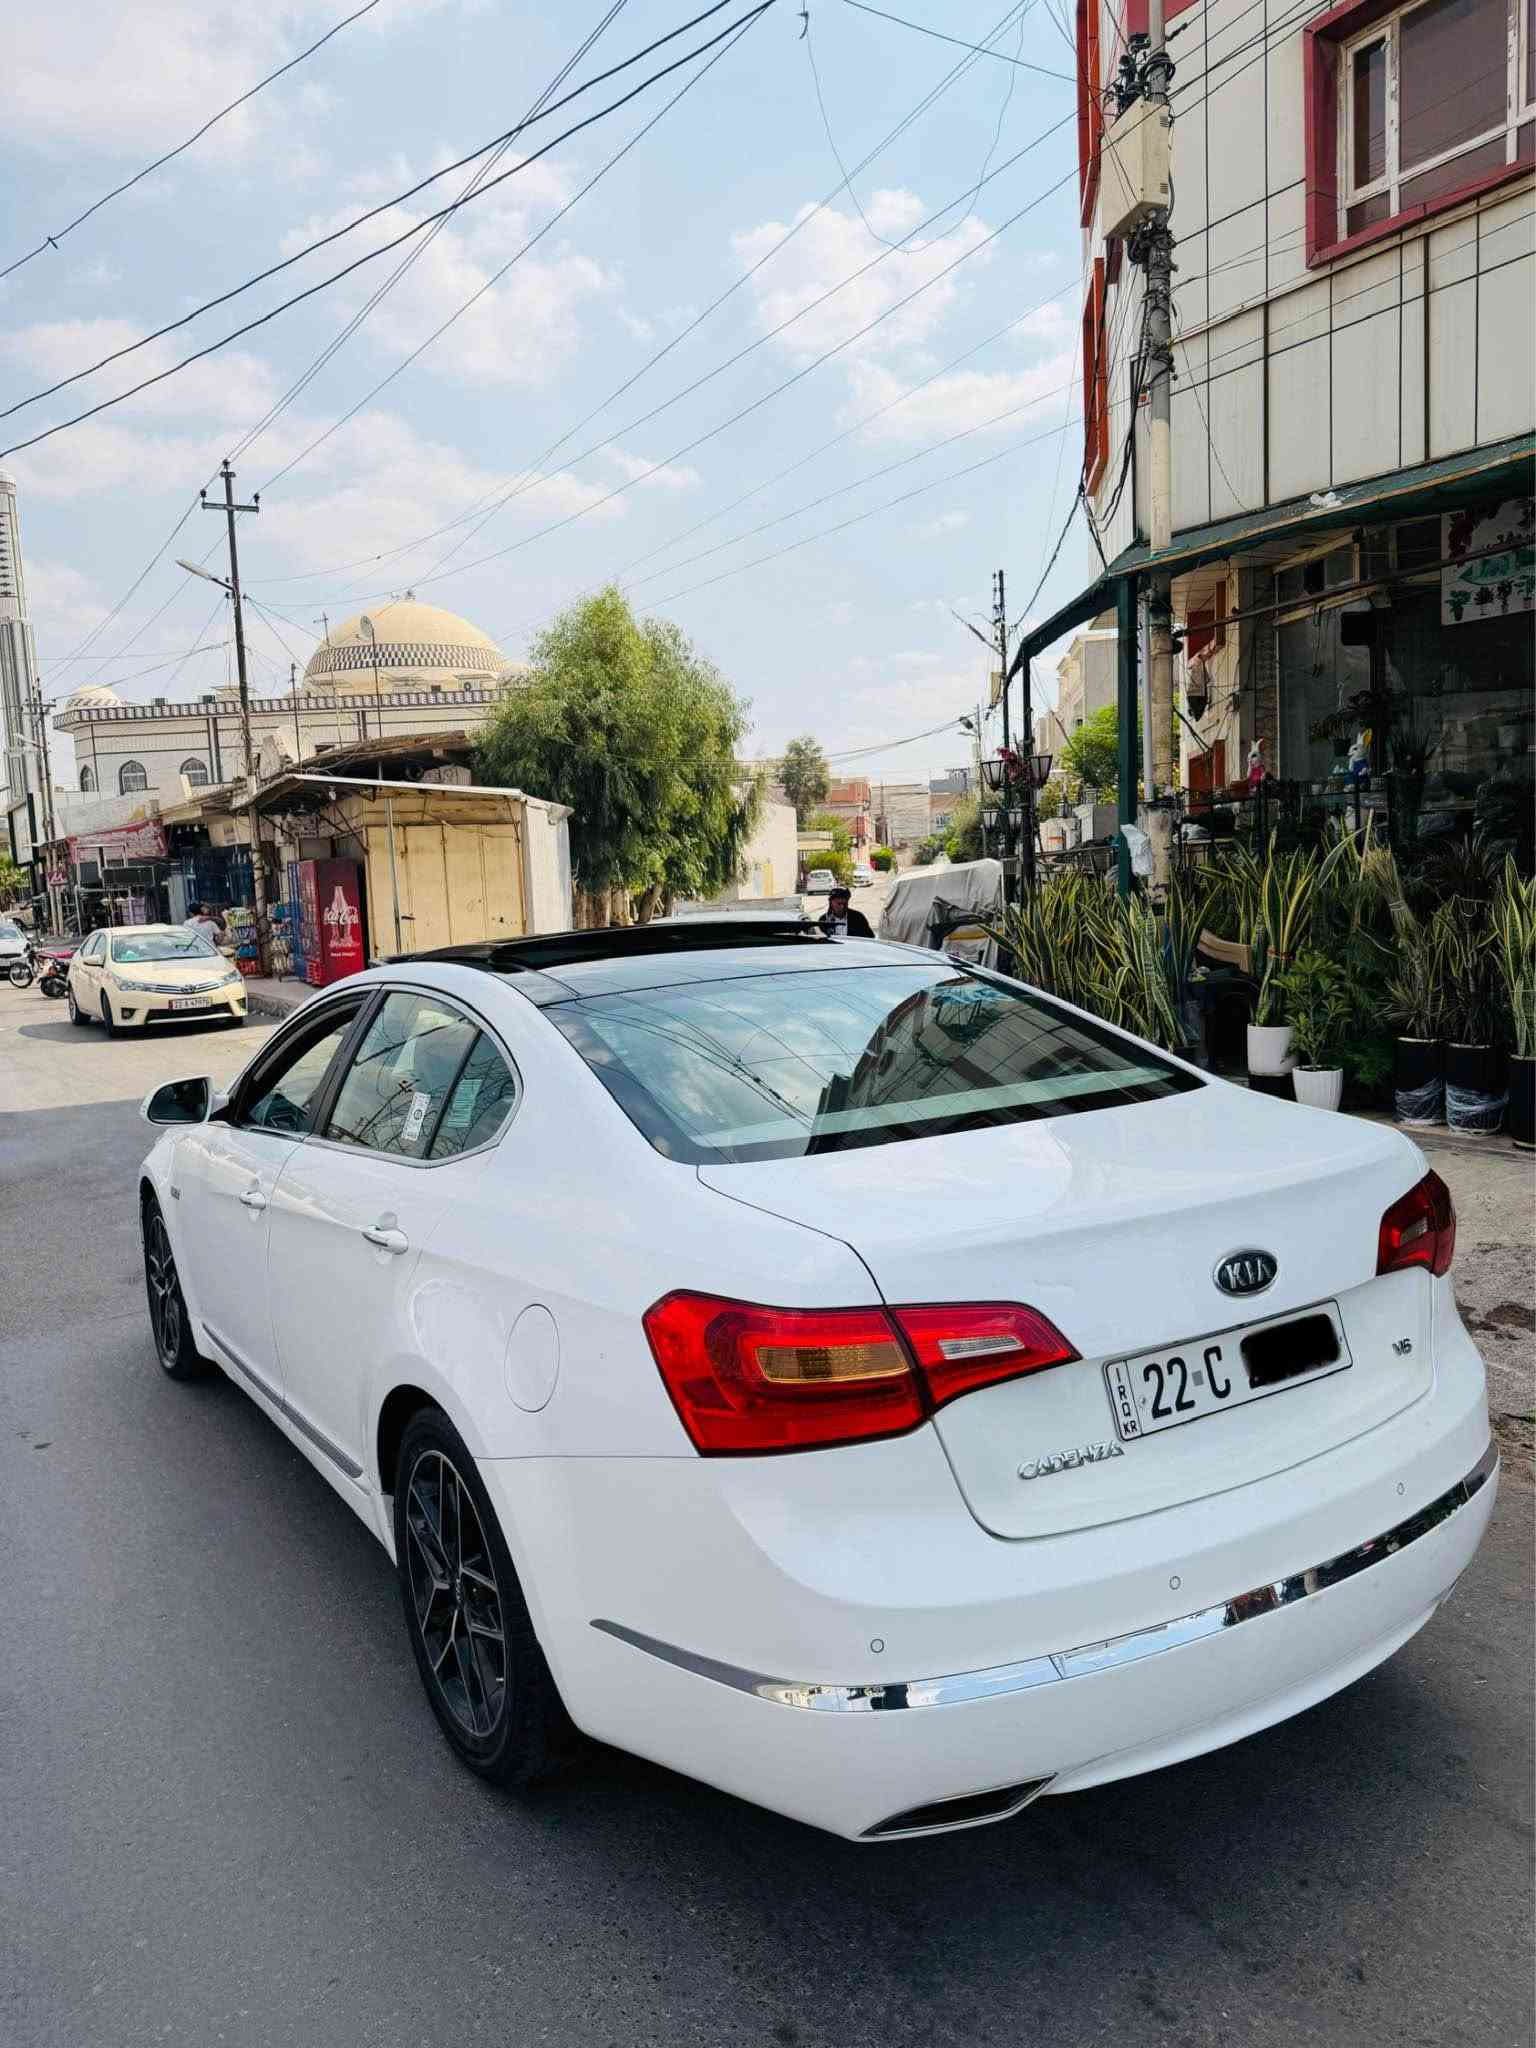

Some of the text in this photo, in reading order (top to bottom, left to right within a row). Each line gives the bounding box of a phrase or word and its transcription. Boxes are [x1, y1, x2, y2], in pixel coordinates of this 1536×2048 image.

[1226, 1259, 1272, 1289] KIA
[1392, 1338, 1412, 1356] V6
[1123, 1421, 1138, 1435] KR
[1018, 1441, 1124, 1479] CADENZA
